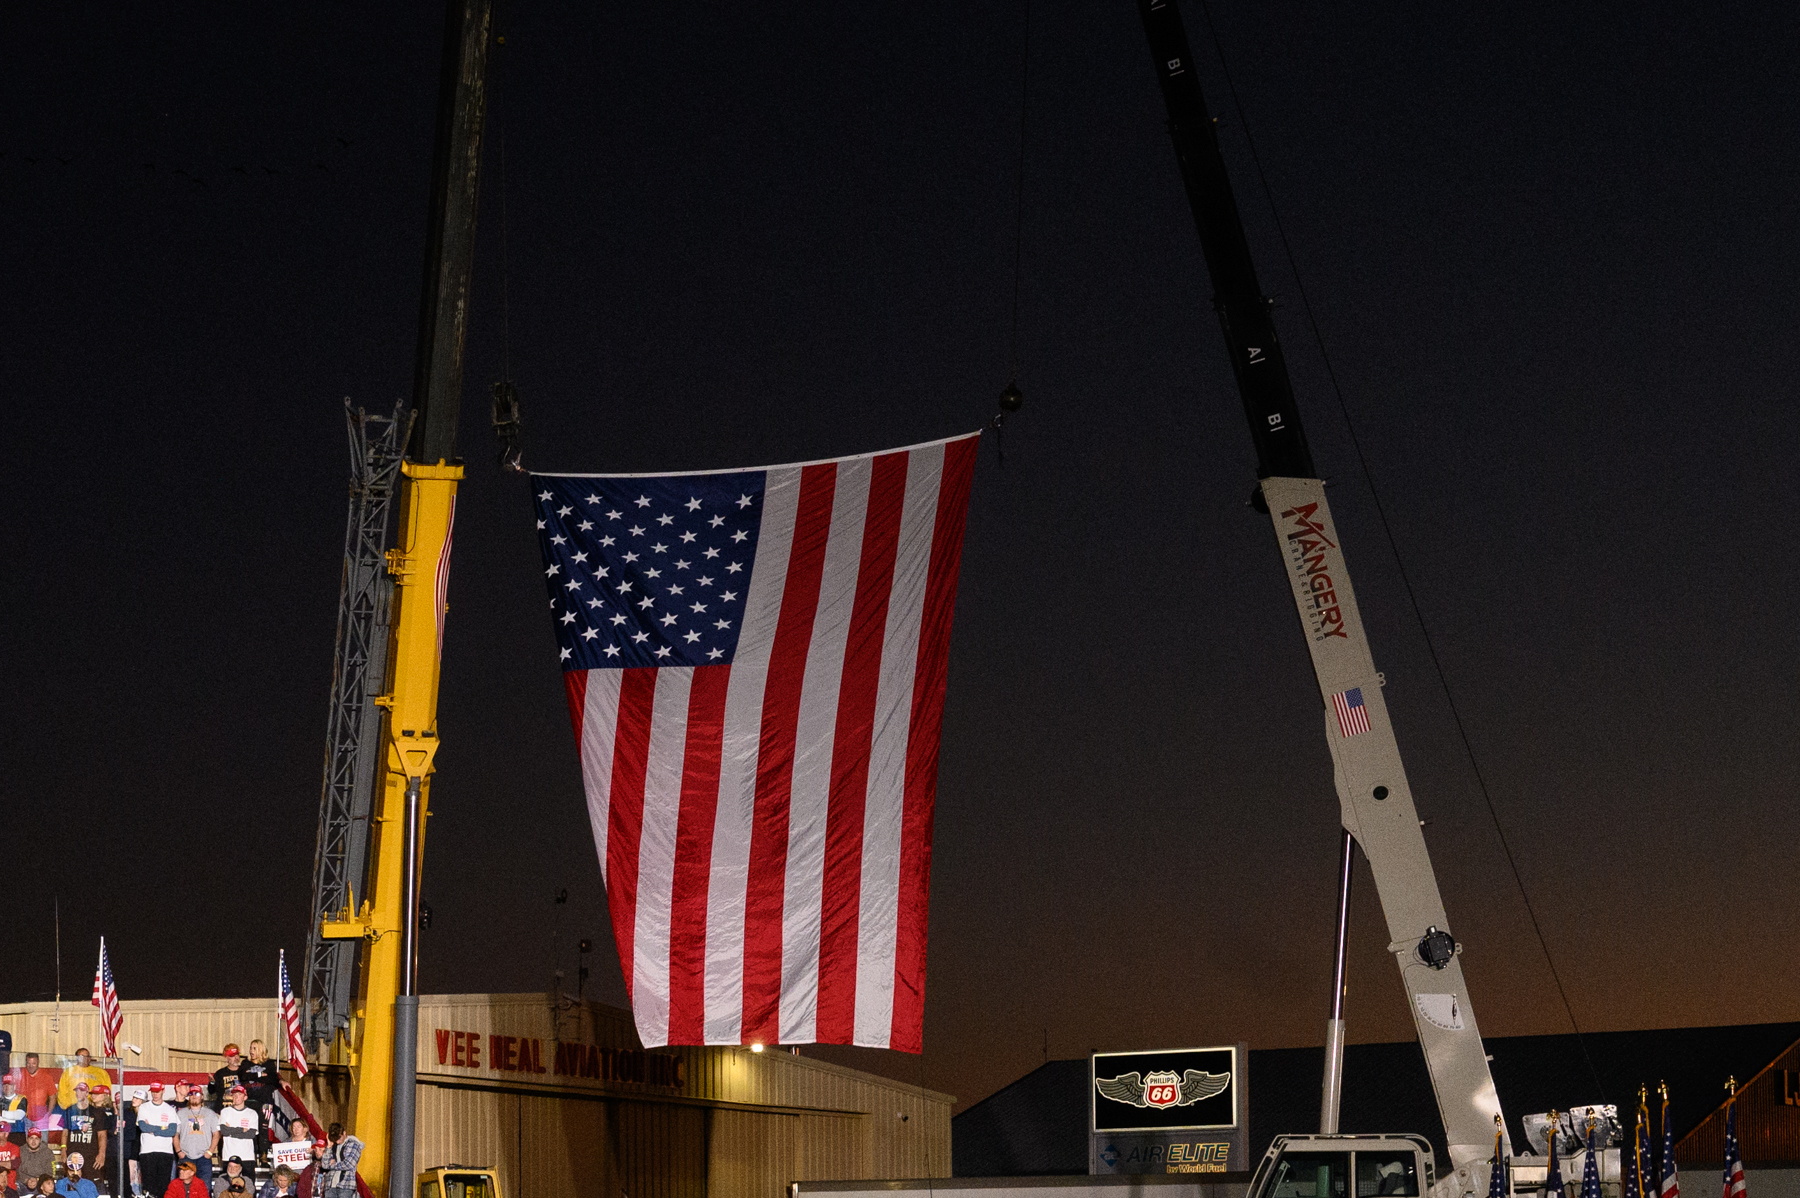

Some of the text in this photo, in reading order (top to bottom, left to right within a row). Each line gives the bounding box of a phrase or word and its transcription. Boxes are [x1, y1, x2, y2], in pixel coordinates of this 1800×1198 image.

[1281, 502, 1348, 639] MANGERY
[1289, 540, 1307, 578] CRANE
[1303, 589, 1324, 642] RIGGING
[435, 1029, 480, 1068] VEE
[489, 1034, 547, 1074] NEAL
[554, 1042, 645, 1082] AVIATION
[1151, 1087, 1173, 1101] 66
[277, 1153, 310, 1163] STEEL
[1127, 1143, 1230, 1163] AIR ELITE
[1167, 1163, 1227, 1174] by World Fuel
